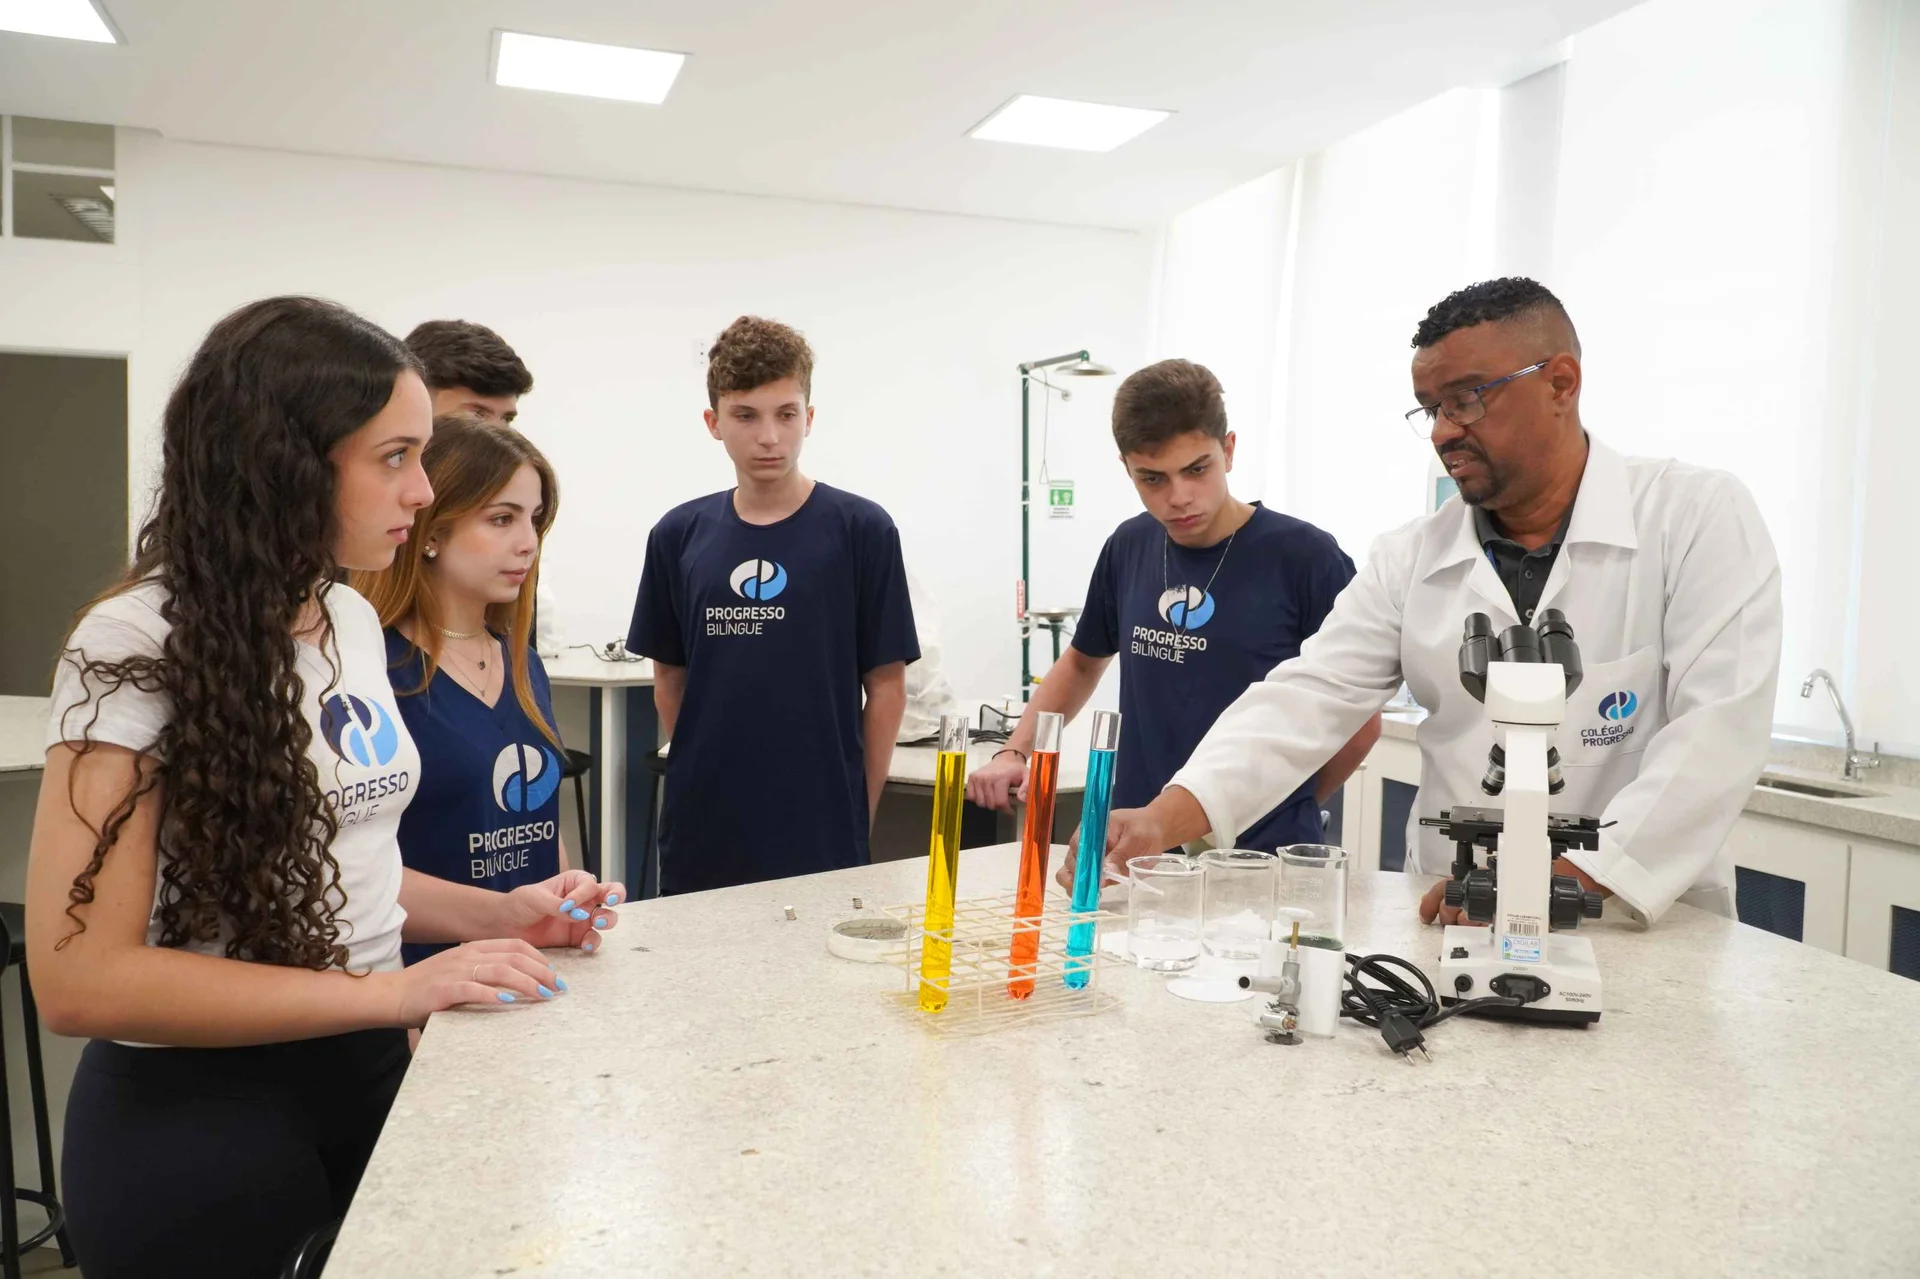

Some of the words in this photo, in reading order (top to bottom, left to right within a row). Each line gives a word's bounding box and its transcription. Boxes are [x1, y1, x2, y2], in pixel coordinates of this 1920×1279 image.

[706, 606, 785, 620] PROGRESSO
[706, 620, 763, 635] BILÍNGUE
[1132, 626, 1207, 651] PROGRESSO
[1131, 641, 1186, 664] BILÍNGUE
[1580, 724, 1623, 737] COLÉGIO
[325, 771, 409, 811] OGRESSO
